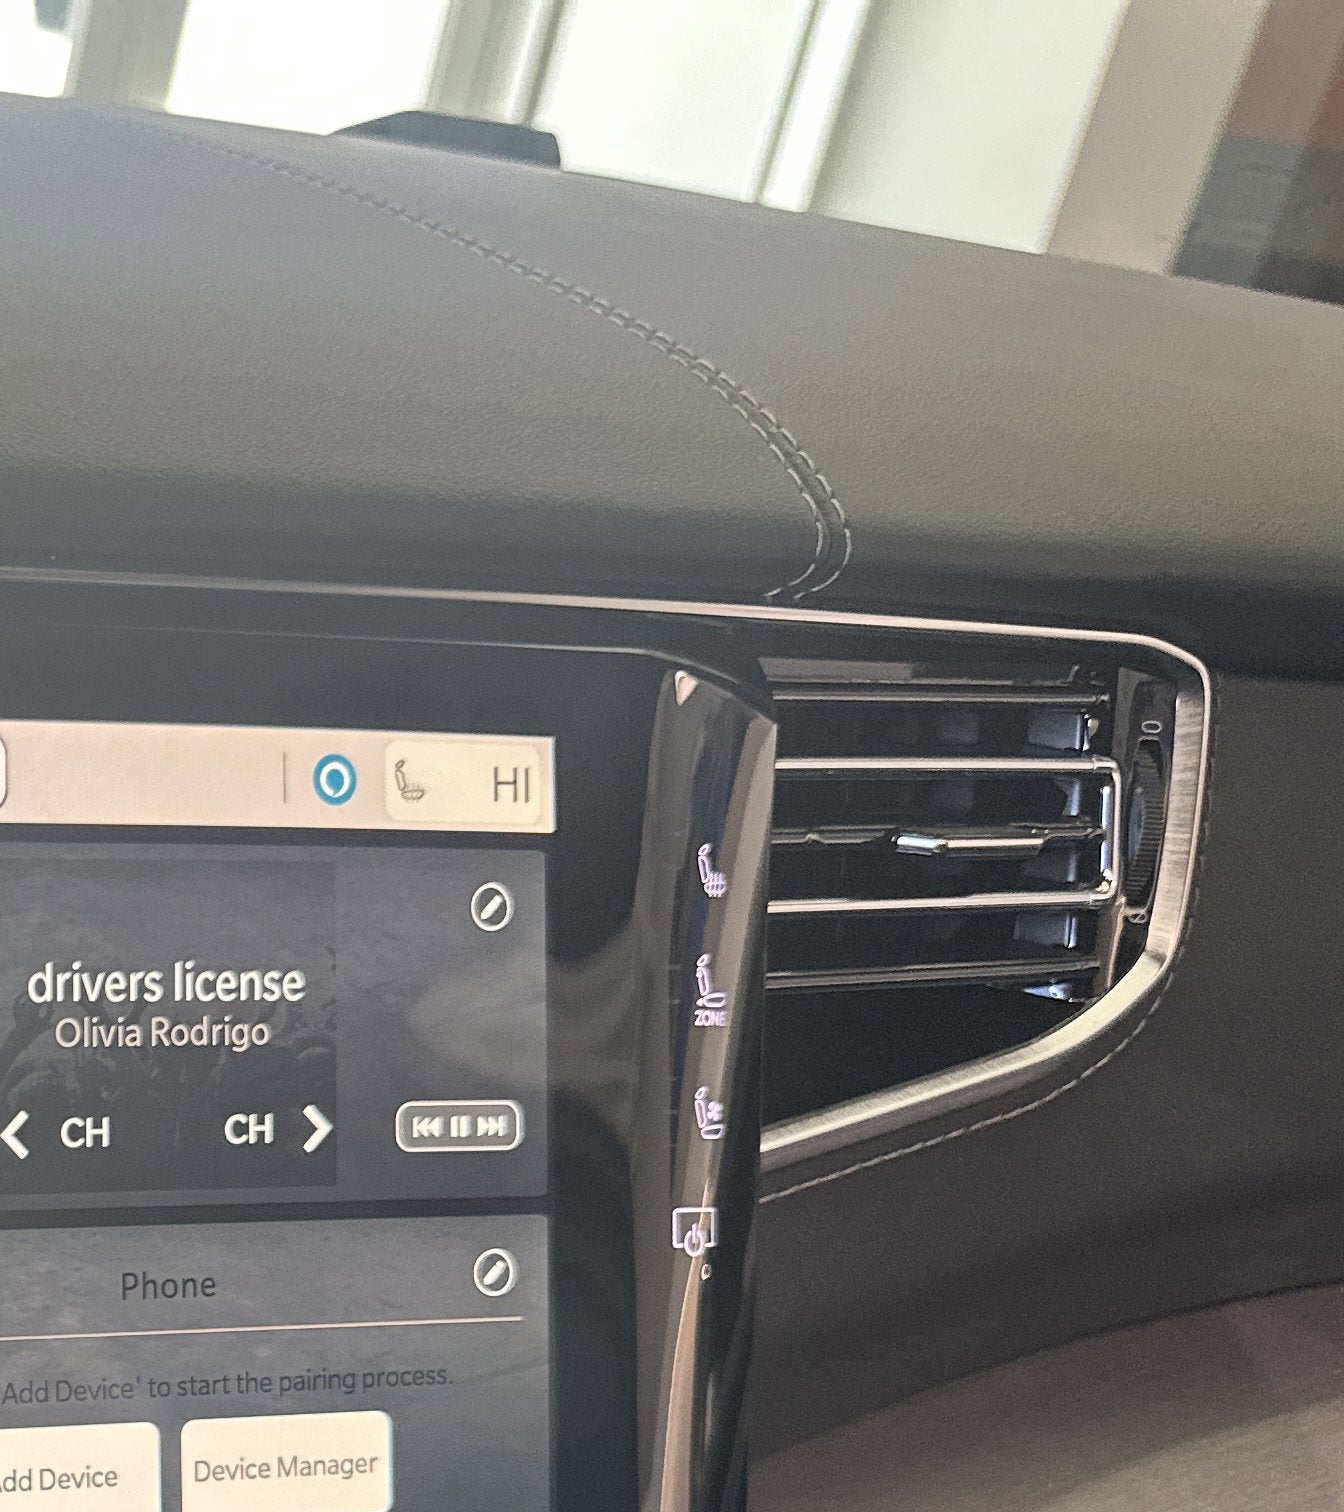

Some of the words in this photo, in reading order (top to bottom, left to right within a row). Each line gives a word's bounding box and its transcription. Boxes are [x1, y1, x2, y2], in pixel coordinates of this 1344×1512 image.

[493, 766, 531, 803] HI
[26, 963, 165, 1005] drivers
[172, 962, 307, 1004] license
[54, 1015, 143, 1049] Olivia
[150, 1015, 271, 1053] Rodrigo
[694, 1010, 727, 1028] ZONE
[60, 1117, 111, 1149] CH
[223, 1113, 275, 1145] CH
[120, 1271, 217, 1300] Phone
[147, 1377, 171, 1400] to
[176, 1376, 229, 1399] start
[234, 1373, 273, 1397] the
[278, 1370, 357, 1398] pairing
[362, 1366, 453, 1394] process.
[38, 1464, 119, 1492] Device
[193, 1457, 271, 1484] Device
[276, 1452, 379, 1485] Manager
